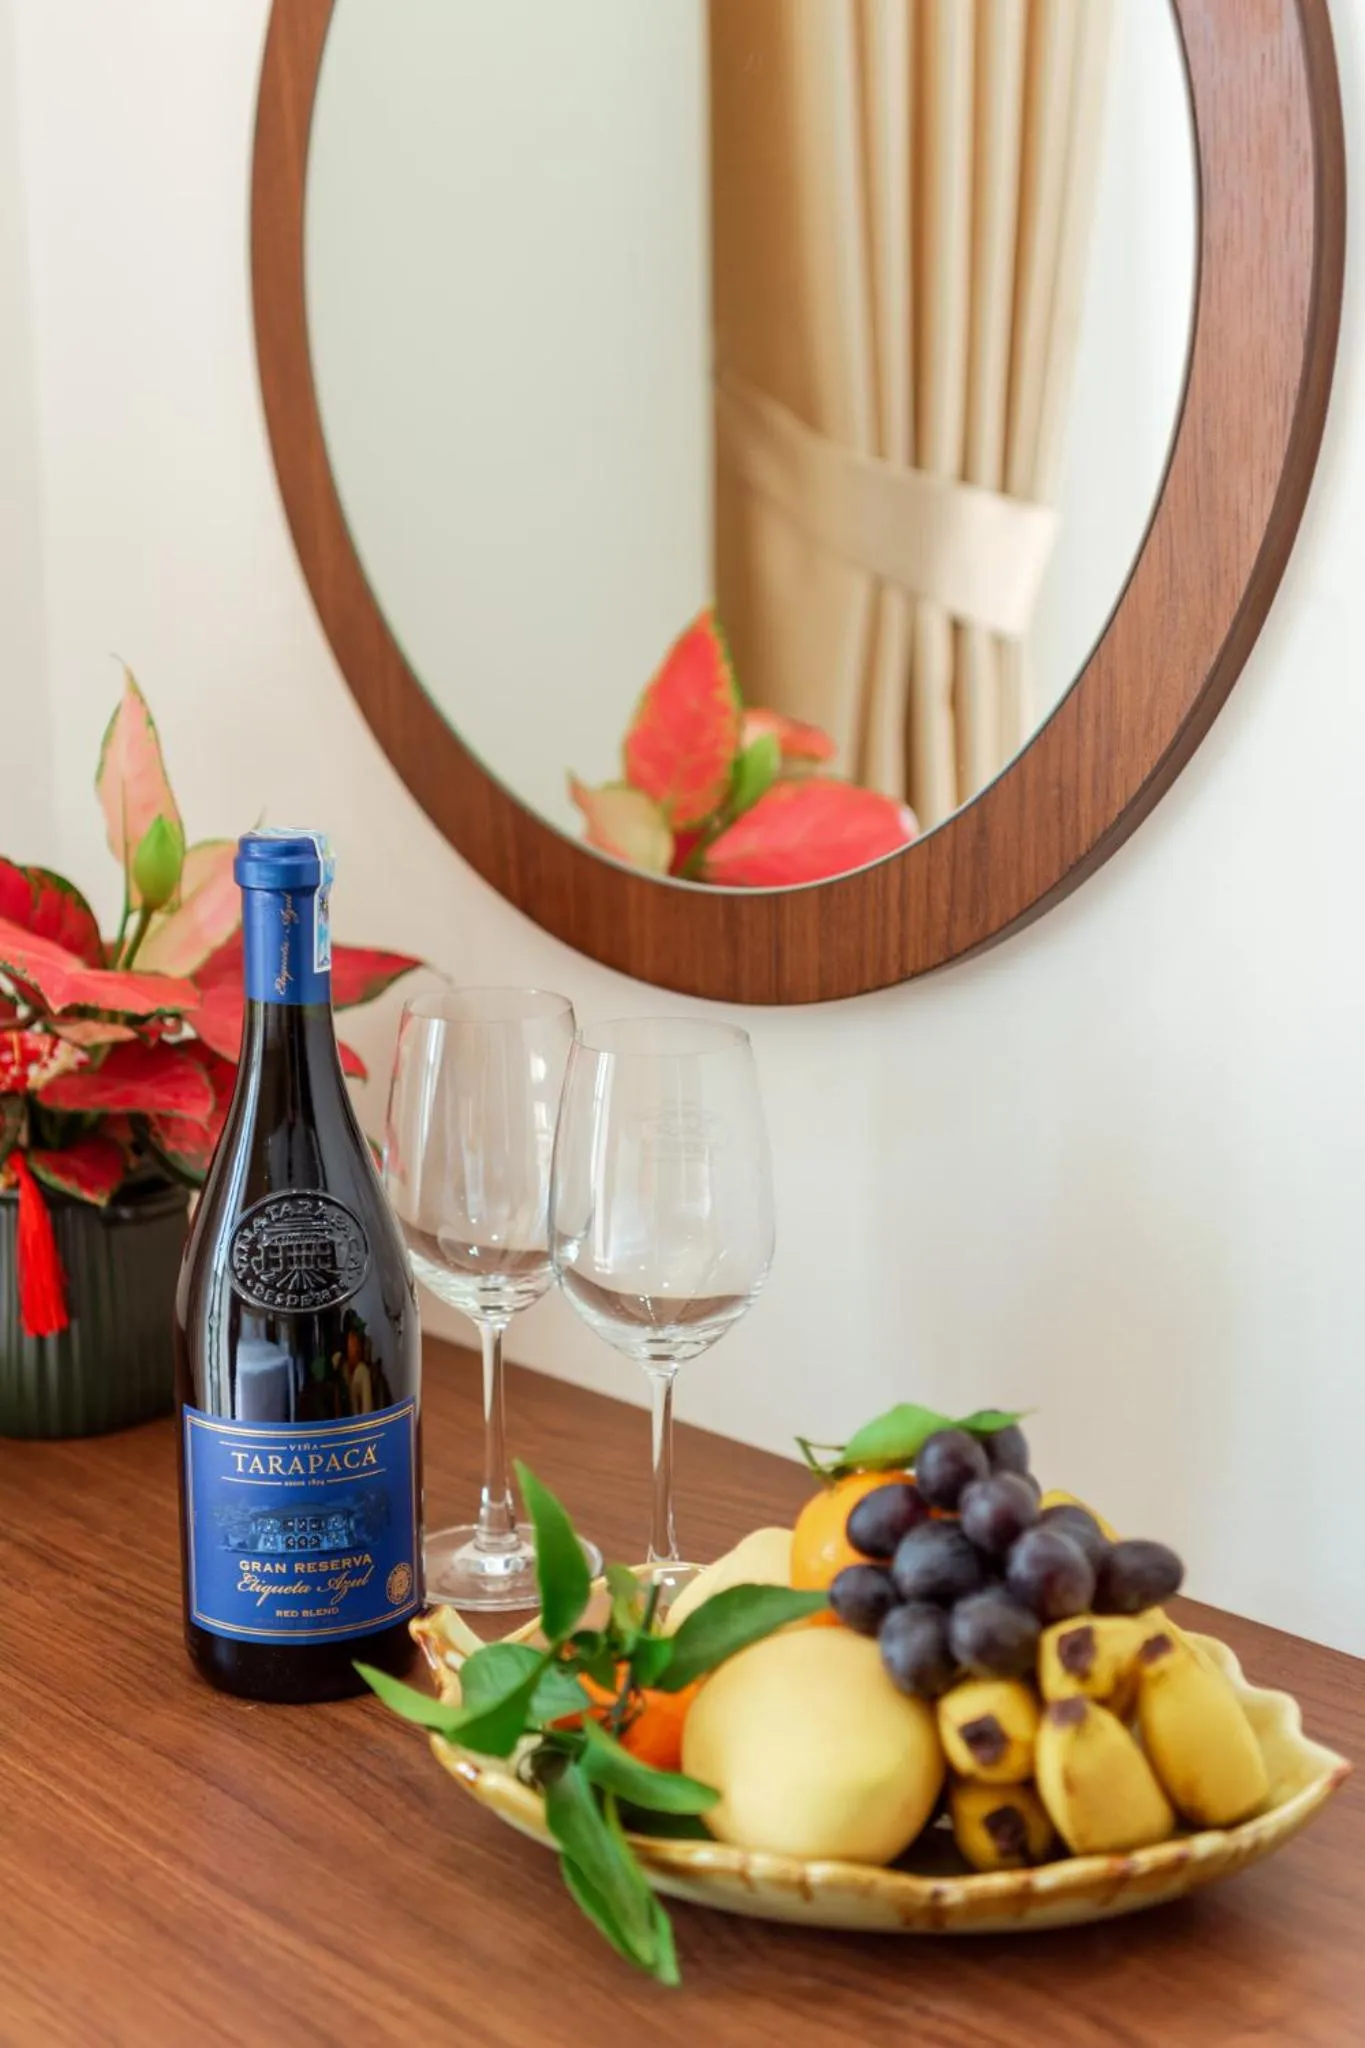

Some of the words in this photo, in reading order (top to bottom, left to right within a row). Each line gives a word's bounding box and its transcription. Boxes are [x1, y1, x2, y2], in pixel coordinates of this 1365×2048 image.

[288, 1442, 319, 1451] VIÑA
[230, 1443, 378, 1476] TARAPACÁ
[239, 1559, 287, 1574] GRAN
[294, 1553, 373, 1574] RESERVA
[236, 1573, 312, 1607] Etiqueta
[317, 1564, 375, 1606] Azul
[275, 1609, 300, 1618] RED
[302, 1607, 340, 1618] BLEND
